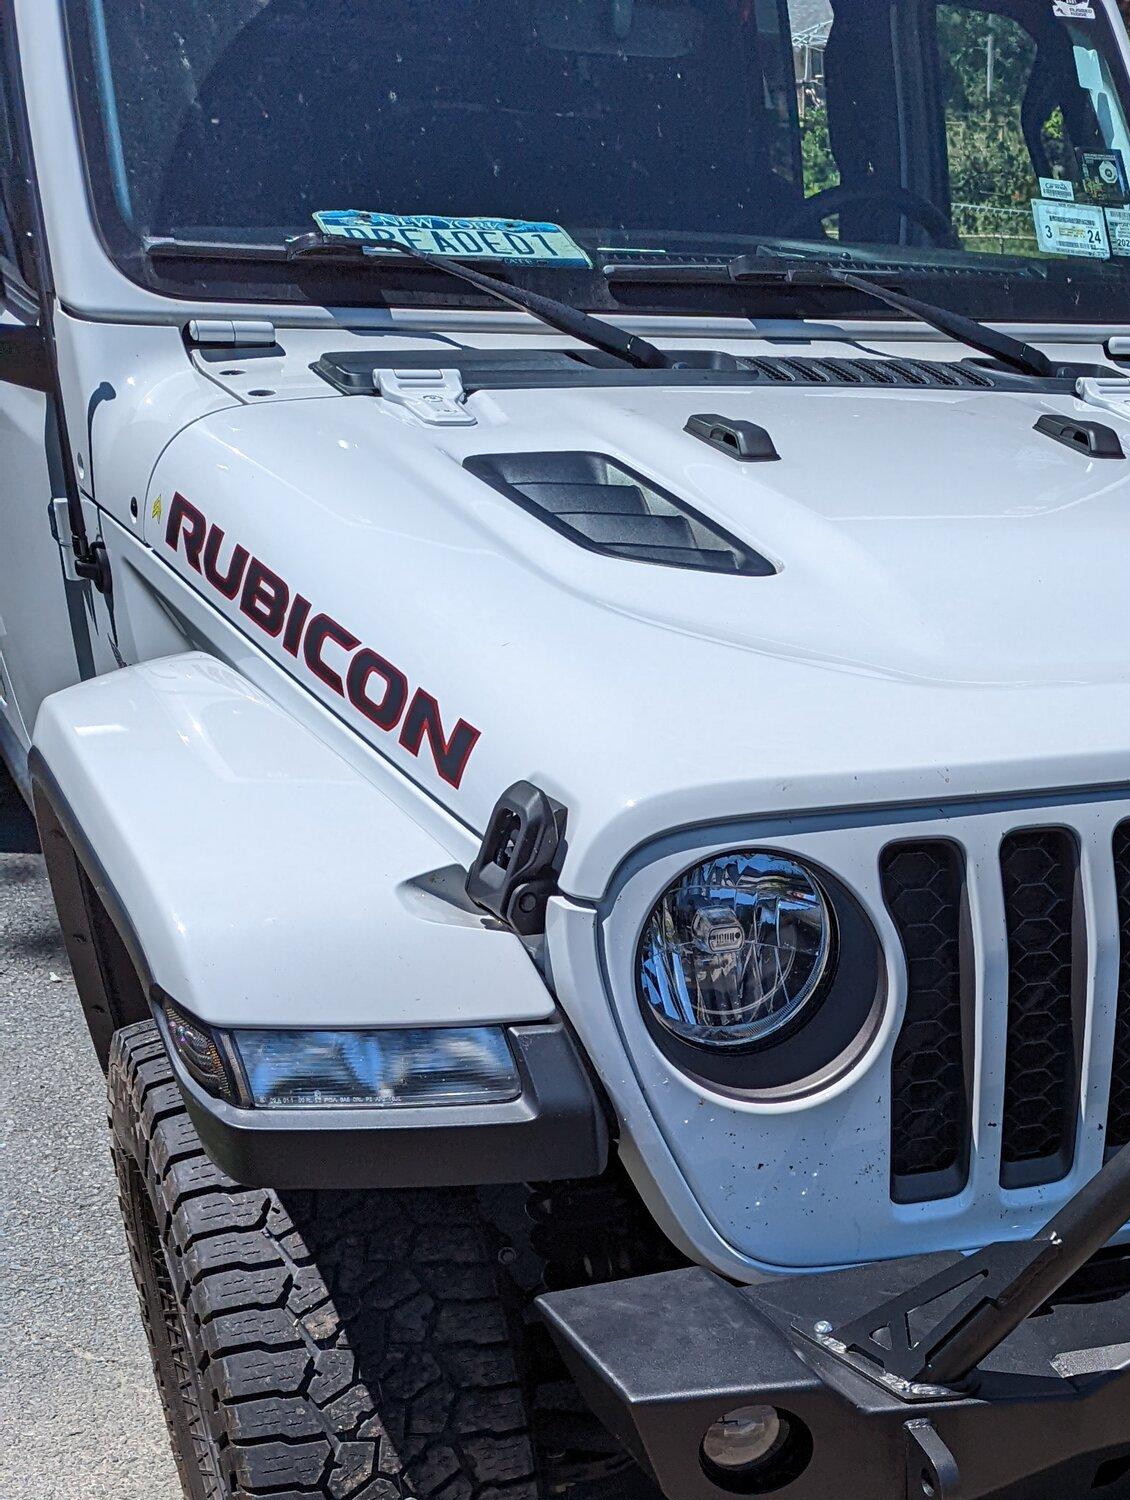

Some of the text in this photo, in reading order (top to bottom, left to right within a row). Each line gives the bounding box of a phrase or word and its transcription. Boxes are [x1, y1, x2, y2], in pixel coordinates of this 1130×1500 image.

[379, 216, 433, 228] NEW
[1045, 225, 1053, 238] 3
[1087, 229, 1101, 244] 24
[165, 491, 482, 790] RUBICON
